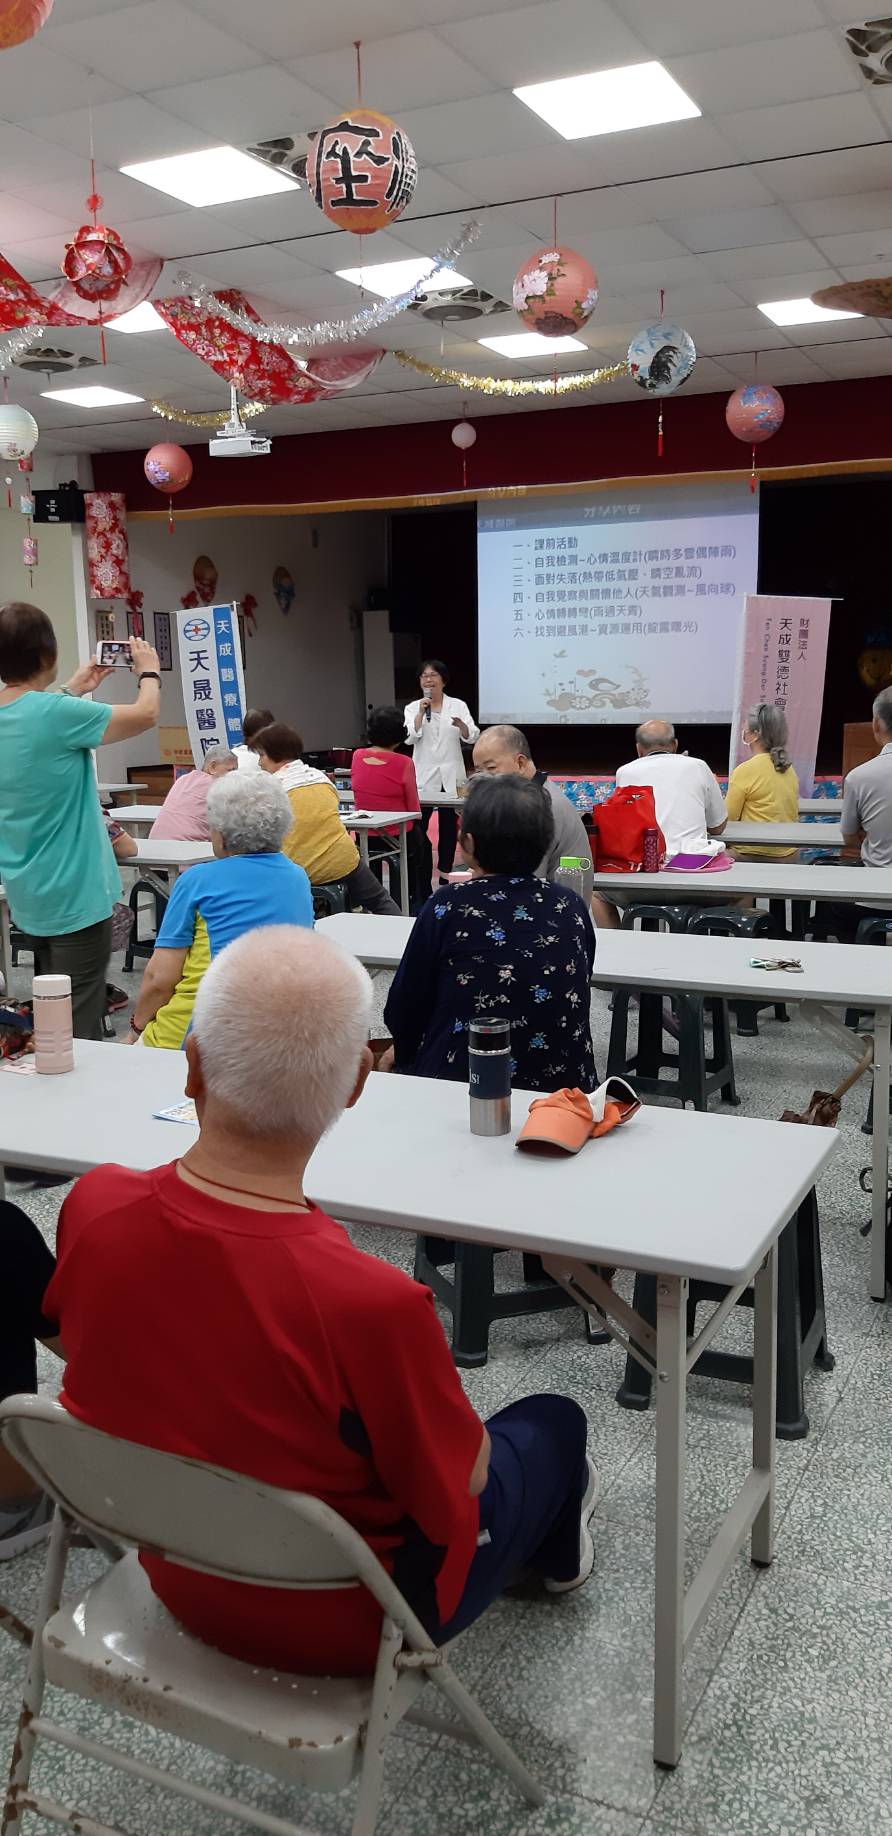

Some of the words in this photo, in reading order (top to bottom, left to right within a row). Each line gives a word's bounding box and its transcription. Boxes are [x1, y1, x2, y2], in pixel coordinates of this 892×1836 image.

[314, 118, 391, 209] 座
[216, 619, 243, 748] 天成醫療體
[797, 618, 810, 661] 財團法人
